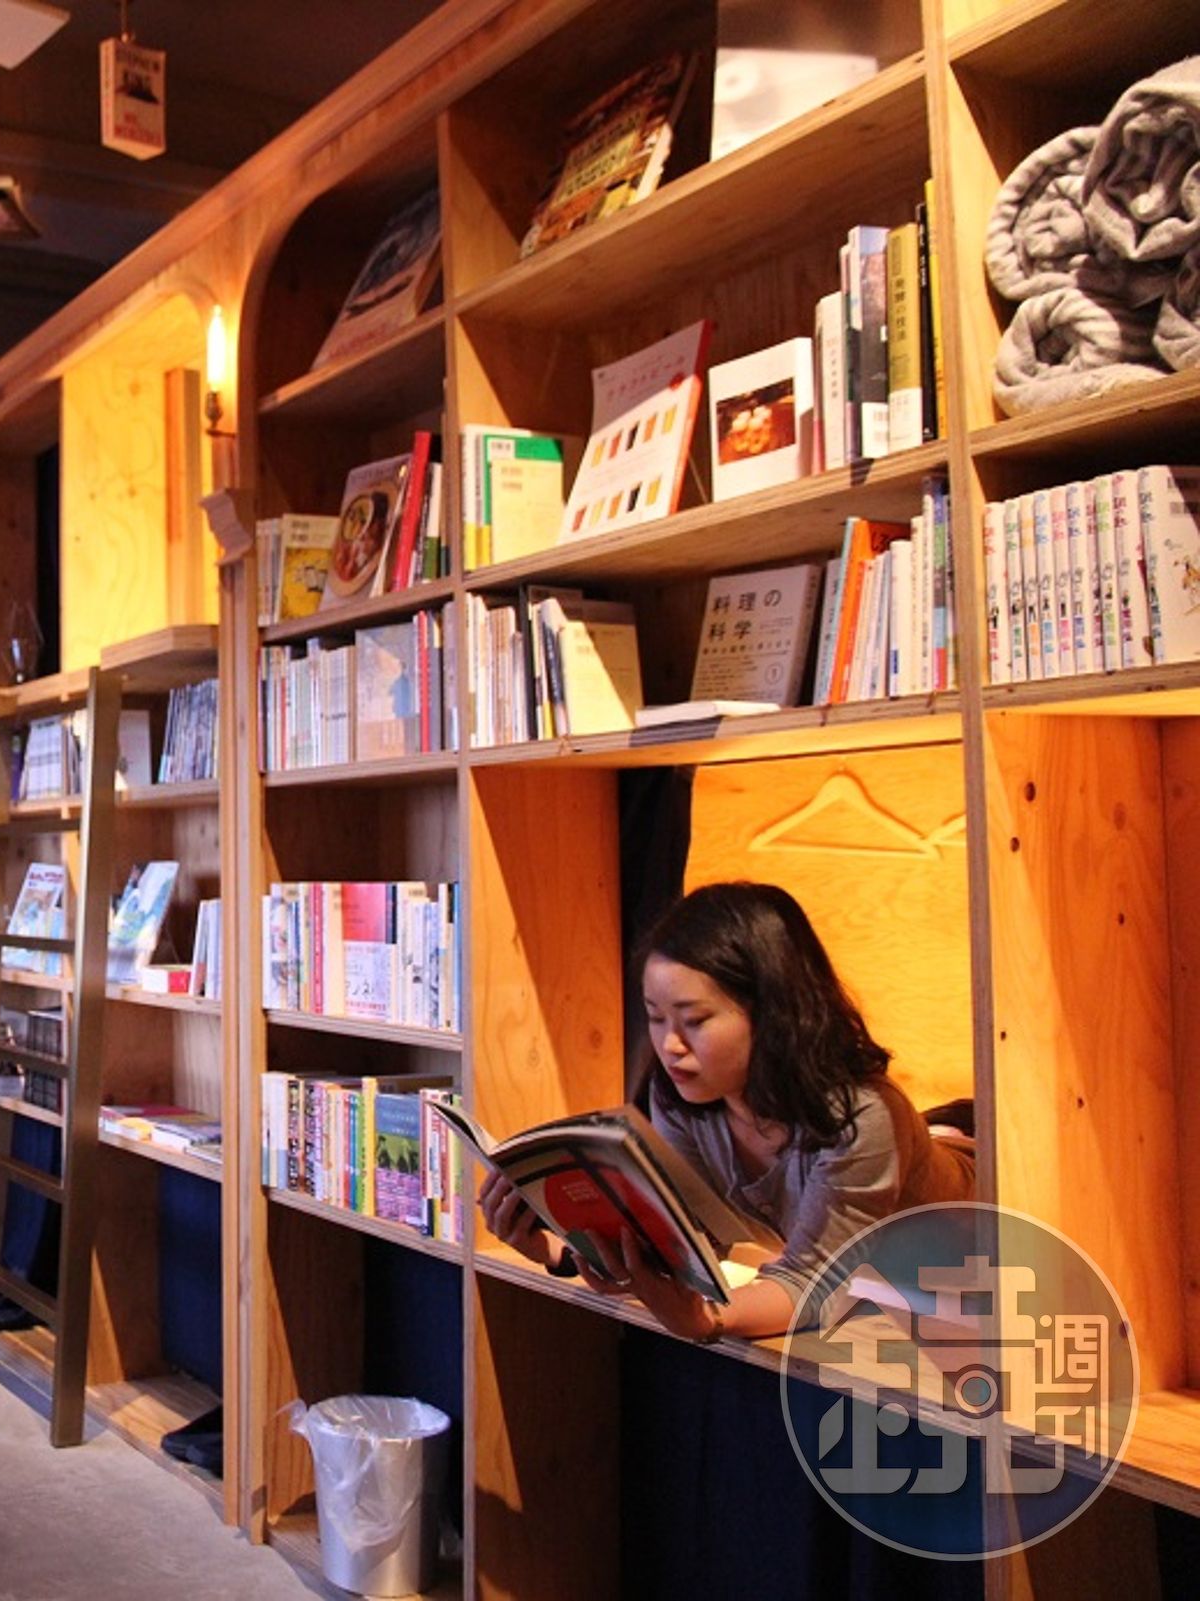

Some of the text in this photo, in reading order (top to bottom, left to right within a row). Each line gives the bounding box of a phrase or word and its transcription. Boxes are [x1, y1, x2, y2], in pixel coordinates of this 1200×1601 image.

[712, 589, 782, 614] 料理の
[708, 620, 753, 643] 科学
